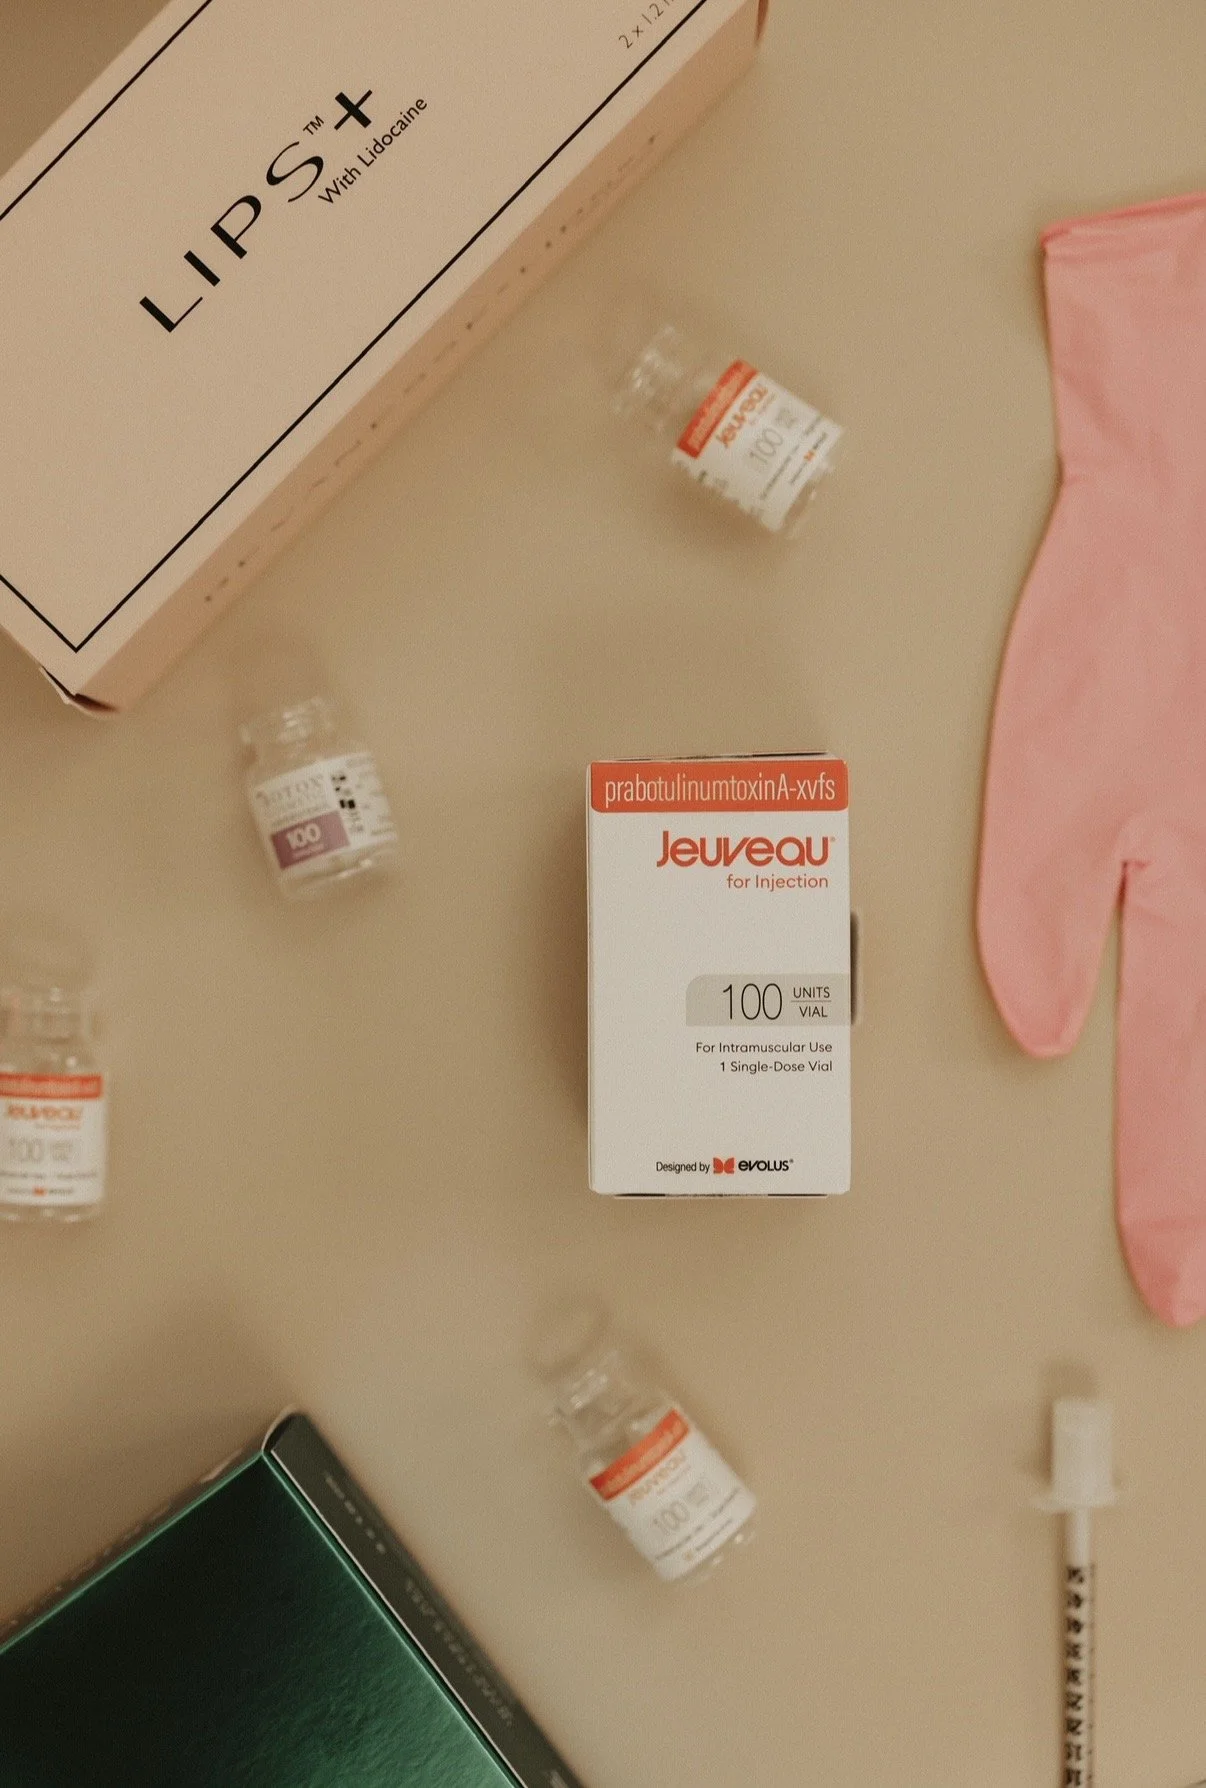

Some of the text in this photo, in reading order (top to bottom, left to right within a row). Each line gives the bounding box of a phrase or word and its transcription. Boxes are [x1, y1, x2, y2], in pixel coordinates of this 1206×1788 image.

[618, 35, 633, 48] 2
[317, 98, 428, 204] With Lidocaine
[749, 427, 784, 465] 100
[605, 772, 835, 808] prabotulinumtoxinA-xvfs
[286, 823, 322, 850] 100
[727, 873, 829, 892] for Injection
[722, 983, 831, 1020] 100 UNITS
[799, 1006, 828, 1018] VIAL
[696, 1042, 833, 1054] For Intramuscular Use
[720, 1061, 833, 1075] 1 Single-Dose Vial
[656, 1161, 697, 1175] Designed
[699, 1161, 711, 1175] by
